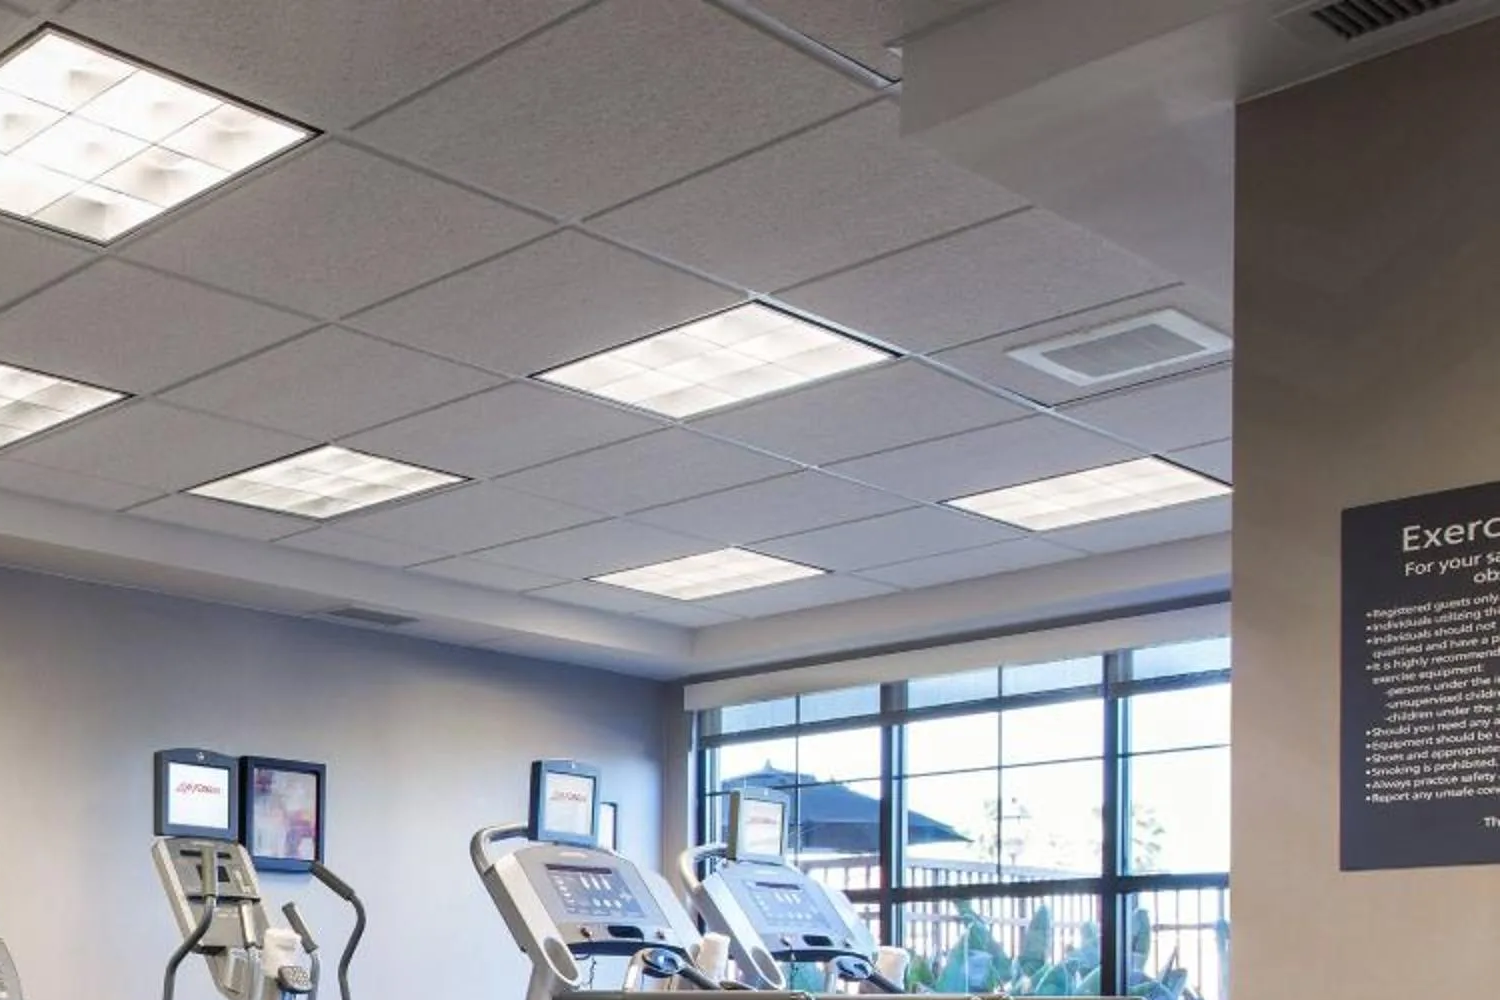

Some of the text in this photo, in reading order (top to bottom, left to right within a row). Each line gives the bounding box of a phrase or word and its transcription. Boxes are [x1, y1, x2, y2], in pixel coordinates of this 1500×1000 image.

[1402, 516, 1500, 552] Exerc
[1405, 561, 1436, 577] For
[1438, 554, 1482, 576] your
[1372, 592, 1499, 620] Registered guests only
[1372, 621, 1497, 645] Individuals should not
[1372, 643, 1423, 660] qualified
[1425, 639, 1448, 652] and
[1450, 638, 1479, 649] have
[1480, 636, 1489, 645] a
[1393, 656, 1429, 671] highly
[1372, 672, 1417, 685] exercise
[1433, 679, 1469, 691] under
[1470, 675, 1491, 687] the
[1435, 705, 1469, 717] under
[1473, 703, 1494, 713] the
[1371, 724, 1411, 737] Should
[1413, 724, 1434, 735] you
[1436, 719, 1467, 731] need
[1468, 718, 1491, 729] any
[1372, 736, 1434, 751] Equipment
[1435, 731, 1475, 745] should
[1477, 729, 1493, 741] be
[1406, 749, 1429, 761] and
[1371, 764, 1421, 777] Smoking
[1371, 771, 1497, 790] Always practice safety
[1371, 792, 1411, 804] Report
[1412, 790, 1433, 801] any
[1434, 785, 1475, 799] unsafe
